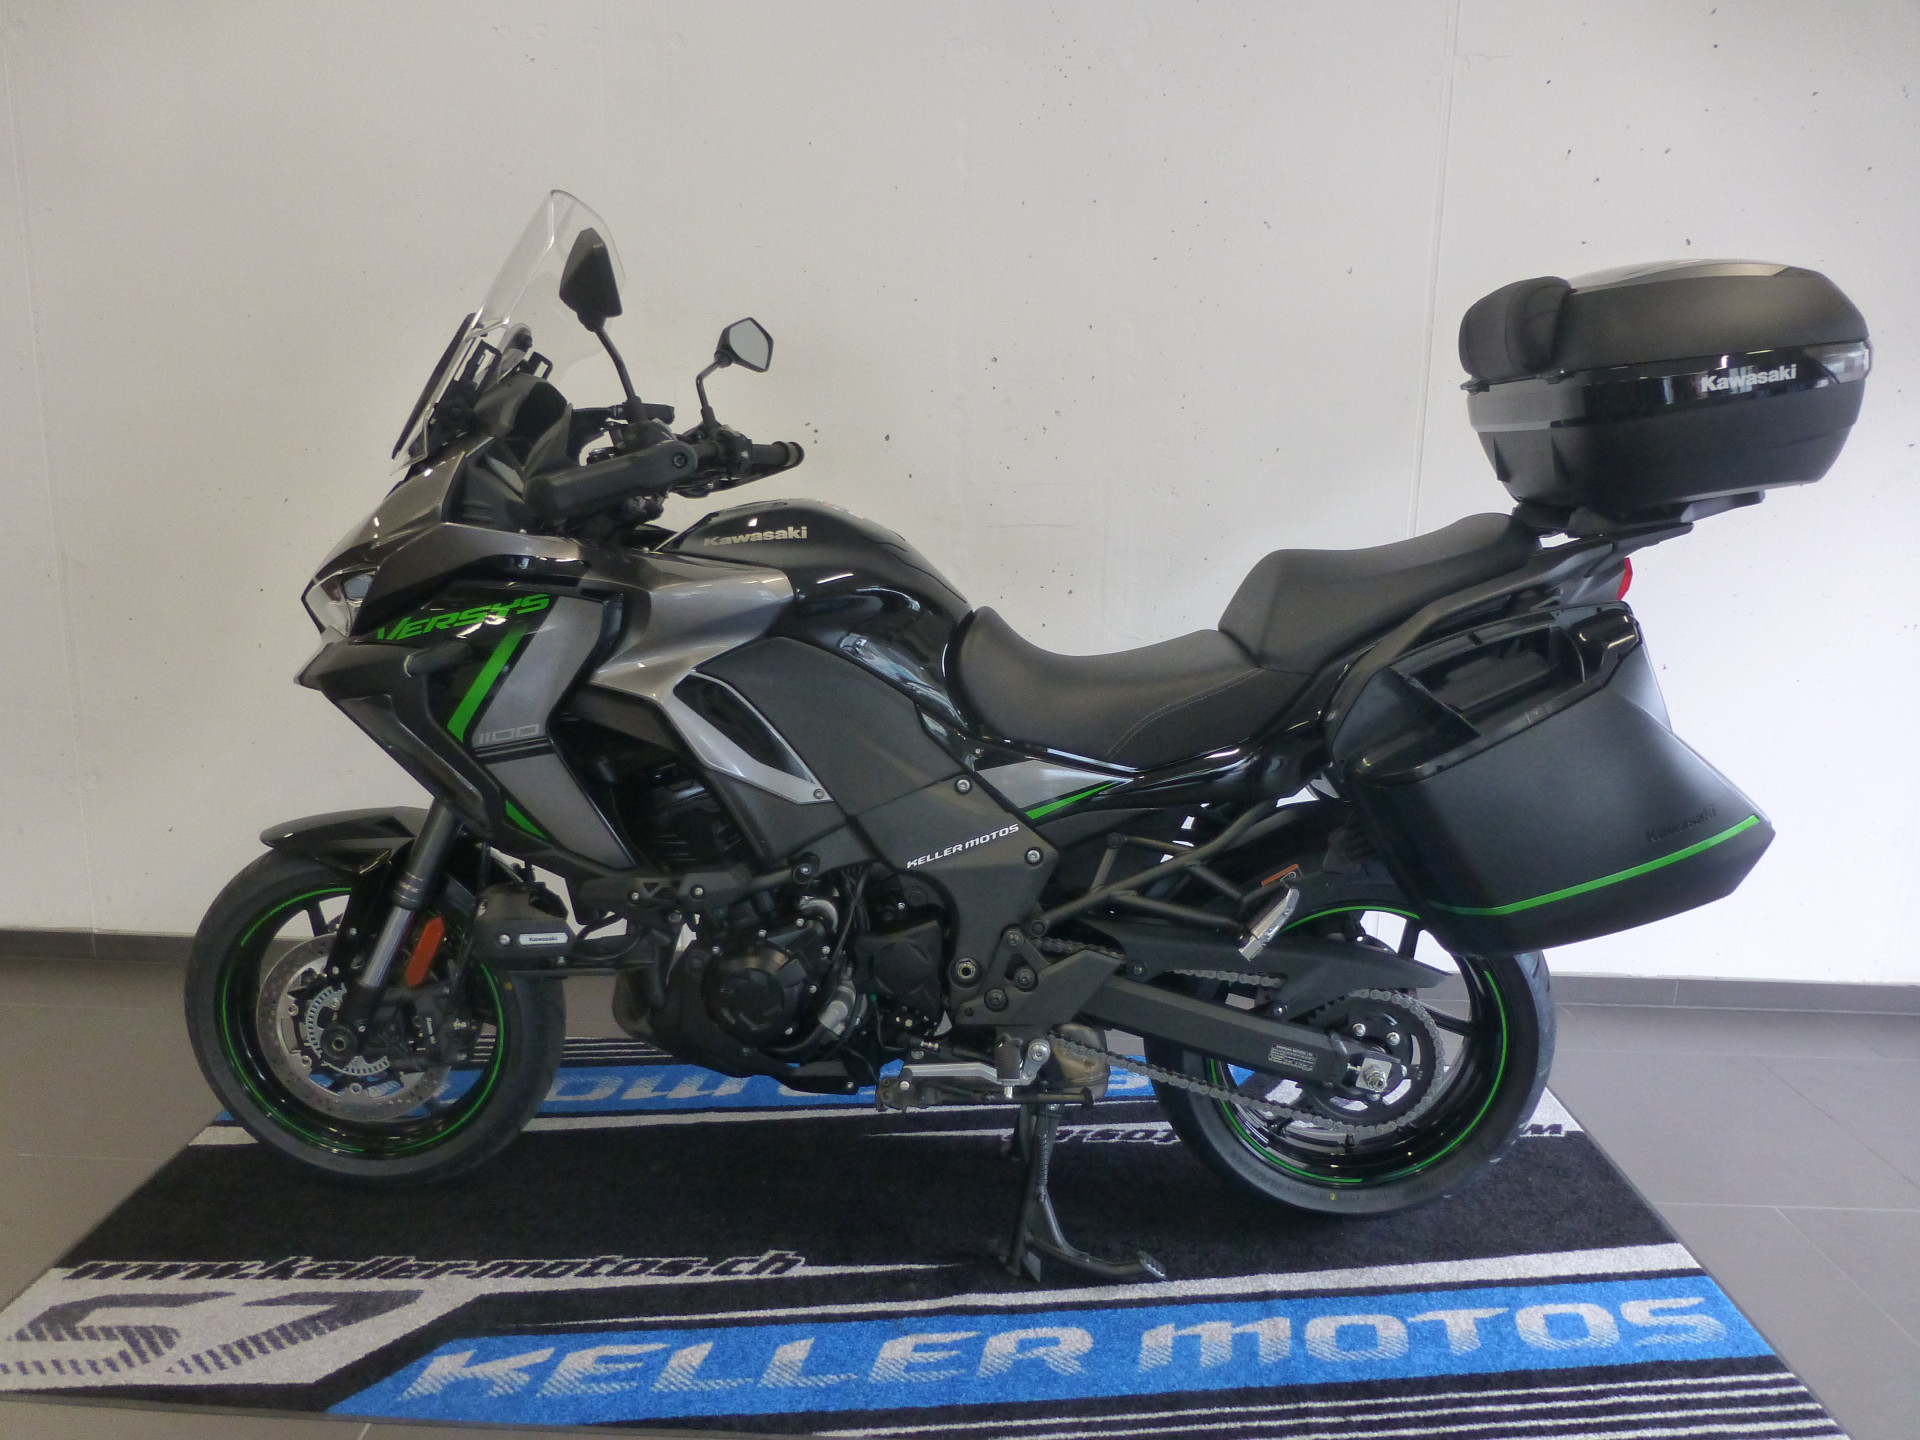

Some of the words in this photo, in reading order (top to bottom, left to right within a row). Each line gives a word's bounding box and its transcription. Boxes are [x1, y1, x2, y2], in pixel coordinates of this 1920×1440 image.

[1701, 363, 1797, 392] Kawasaki
[703, 526, 807, 546] Kawasaki
[377, 593, 550, 640] VERSYS
[479, 723, 540, 744] 1100
[906, 844, 963, 869] KELLER
[964, 823, 1020, 849] MOTOS
[64, 1251, 804, 1280] www.keller-motos.ch
[397, 1325, 1095, 1400] KELLER
[1138, 1296, 1728, 1374] MOTOS
